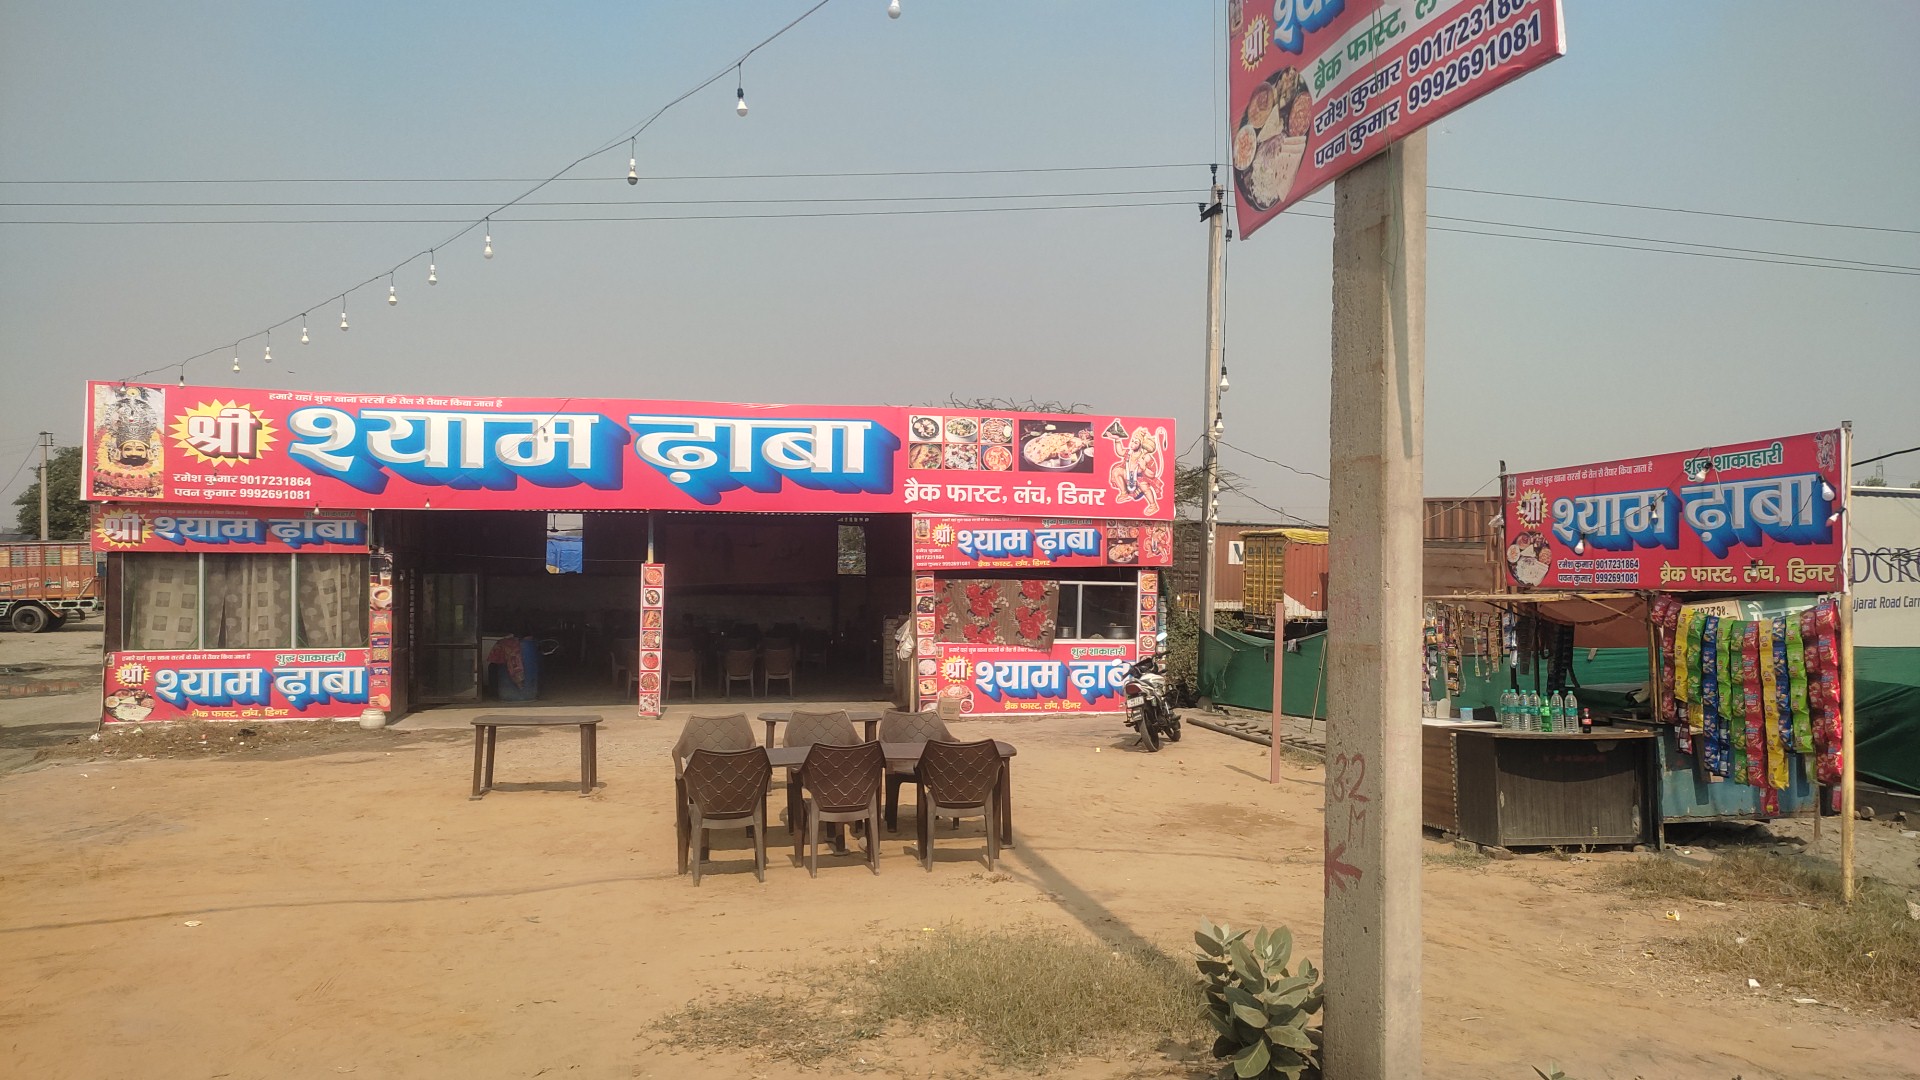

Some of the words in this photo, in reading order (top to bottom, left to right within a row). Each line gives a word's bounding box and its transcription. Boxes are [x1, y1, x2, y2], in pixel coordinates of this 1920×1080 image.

[1315, 132, 1347, 166] पवन
[1349, 100, 1400, 151] कुमार
[1408, 14, 1540, 111] 9992691081
[1315, 95, 1348, 134] रमेश
[1350, 60, 1402, 114] कुमार
[187, 406, 261, 459] श्री
[288, 405, 604, 474] श्याम
[628, 413, 874, 485] ढ़ाबा
[1713, 442, 1783, 472] शाकाहारी
[173, 472, 201, 483] रमेश
[239, 475, 312, 487] 9017231864
[174, 487, 200, 497] पवन
[202, 488, 237, 500] कुमार
[239, 488, 311, 500] 9992691081
[903, 476, 942, 504] ब्रैक
[946, 484, 1008, 504] फास्ट,
[1013, 480, 1052, 505] लंच,
[1057, 481, 1106, 506] डिनर
[1522, 492, 1546, 523] श्री
[1551, 488, 1671, 541] श्याम
[1681, 474, 1817, 542] ढ़ाबा
[104, 512, 143, 543] श्री
[153, 516, 259, 540] श्याम
[267, 517, 359, 543] ढ़ाबा
[933, 527, 954, 546] श्री
[957, 528, 1028, 553] श्याम
[1034, 528, 1096, 554] ढ़ाबा
[1595, 558, 1639, 570] 9017231864
[1595, 572, 1639, 584] 9992691081
[1660, 561, 1687, 585] ब्रैक
[1691, 566, 1738, 584] फास्ट,
[1786, 557, 1837, 584] डिनर
[1880, 595, 1901, 609] Road
[276, 653, 297, 666] शुद्ध
[298, 651, 346, 664] शाकाहारी
[120, 664, 146, 686] श्री
[154, 667, 263, 701] श्याम
[272, 666, 366, 702] ढ़ाबा
[945, 660, 969, 681] श्री
[975, 661, 1062, 692] श्याम
